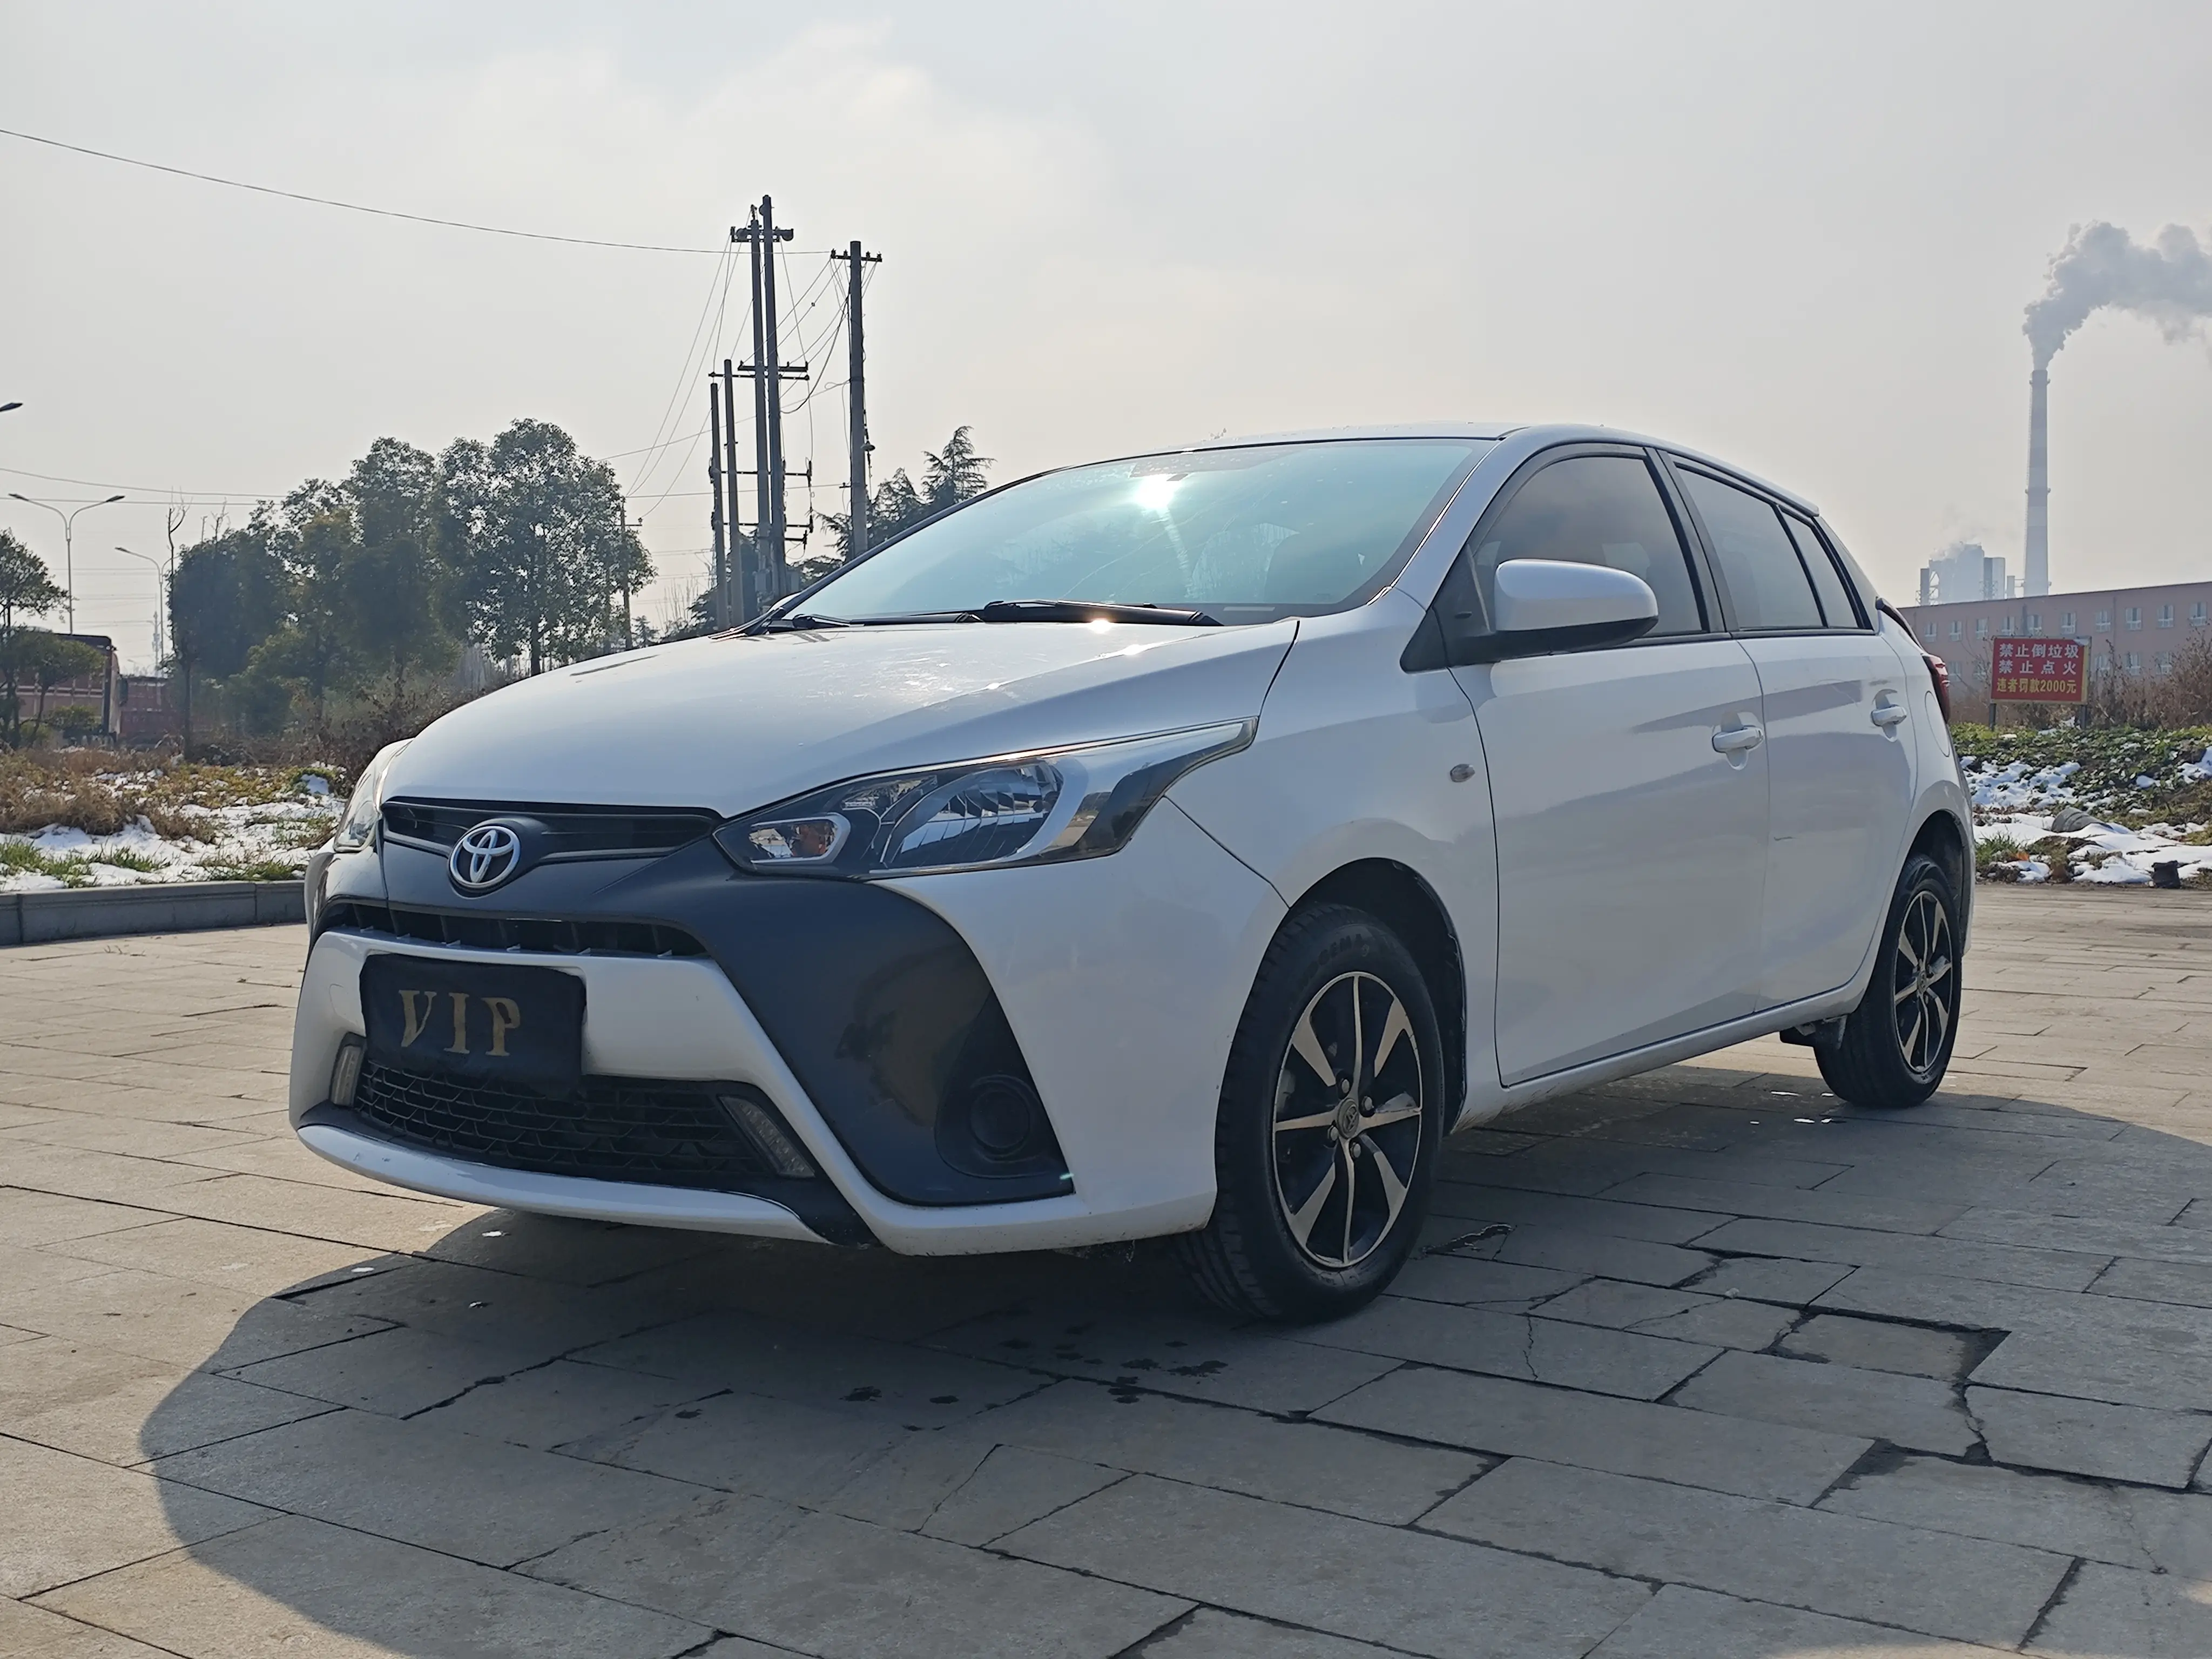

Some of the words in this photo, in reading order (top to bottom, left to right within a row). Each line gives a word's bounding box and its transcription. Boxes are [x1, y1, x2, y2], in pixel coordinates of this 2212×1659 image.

[1999, 643, 2079, 658] 禁止倒垃圾
[1999, 659, 2076, 675] 禁止点火
[398, 989, 521, 1056] VIP
